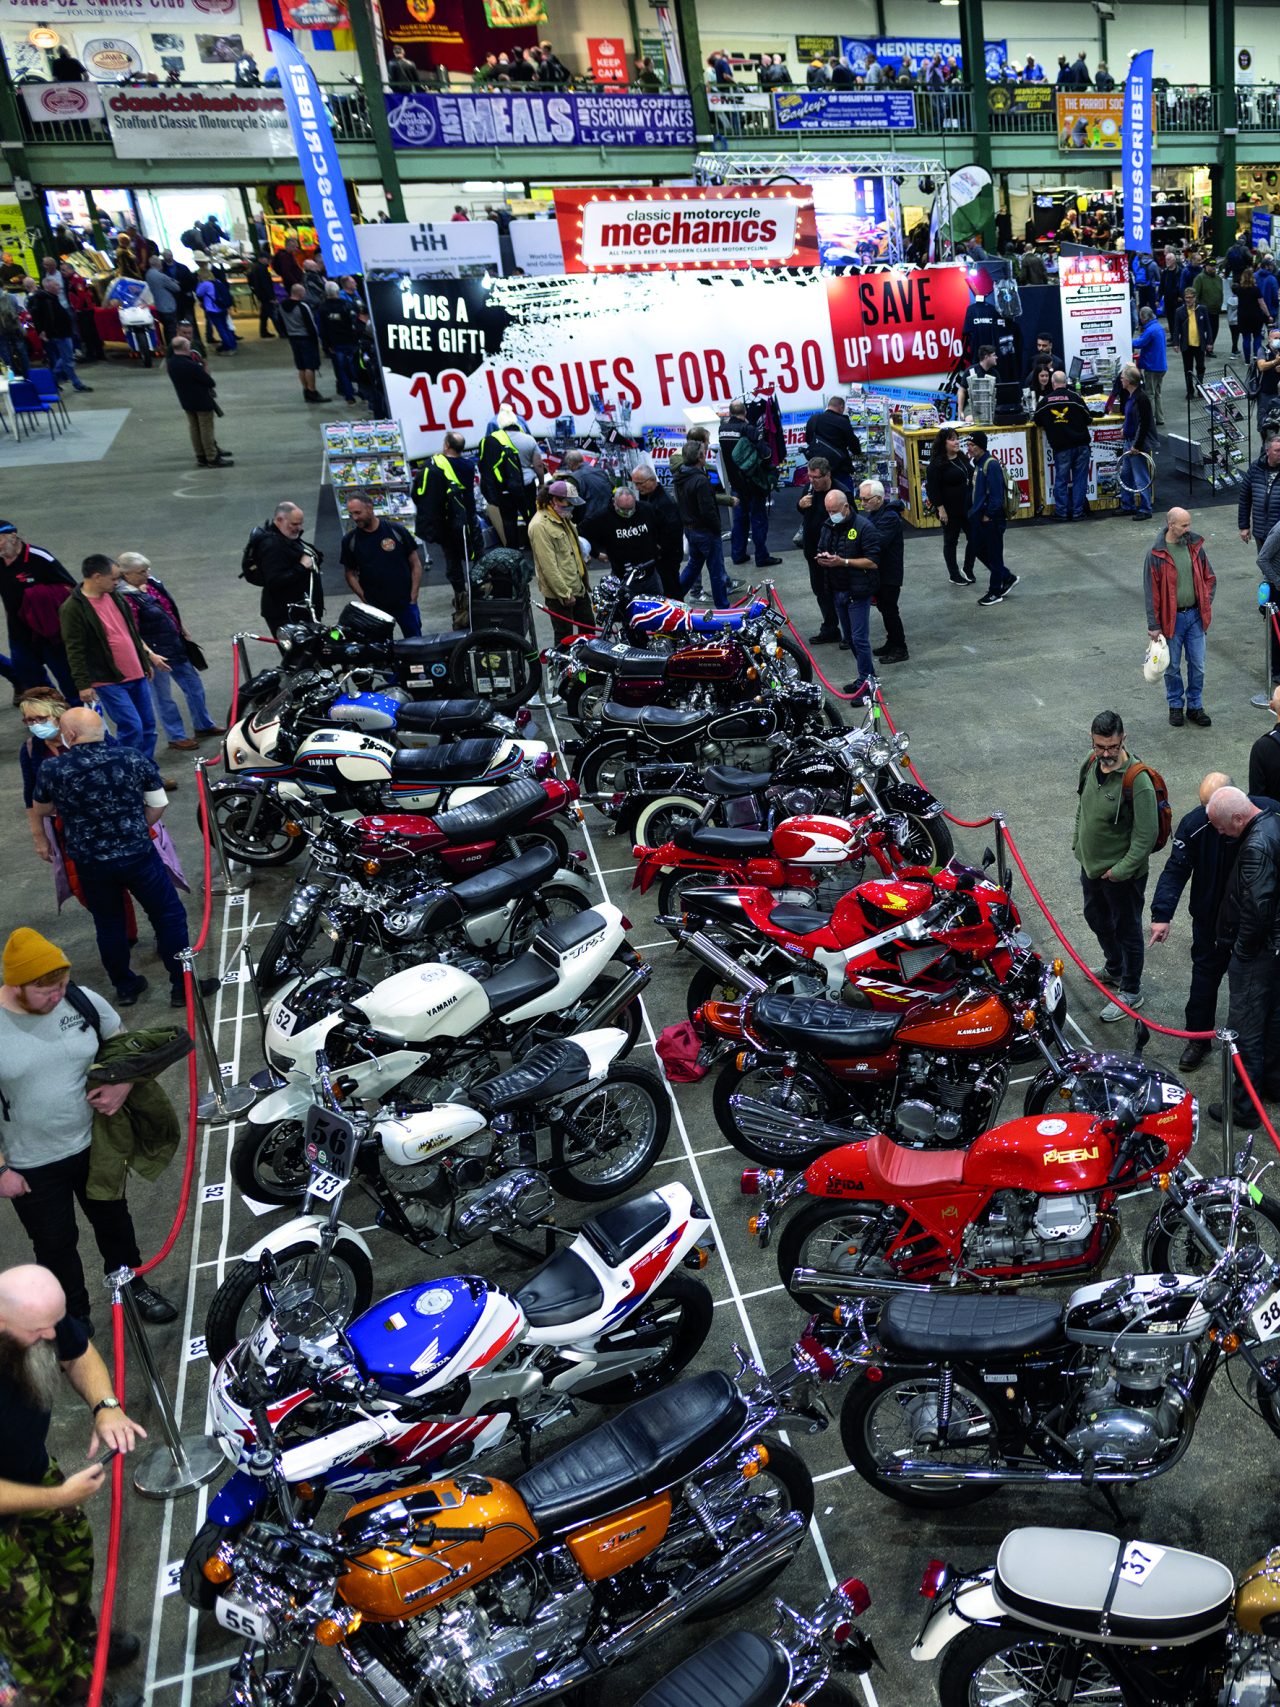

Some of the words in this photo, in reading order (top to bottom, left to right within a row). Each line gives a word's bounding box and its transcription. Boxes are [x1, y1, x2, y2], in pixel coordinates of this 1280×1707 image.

[66, 9, 113, 17] FOUNDED
[876, 42, 963, 57] HEDNESFOR
[597, 58, 621, 67] KEEP
[109, 91, 286, 113] classicbikeshows
[577, 98, 639, 109] DELICIOUS
[641, 99, 692, 110] COFFEES
[1064, 98, 1079, 110] THE
[1079, 98, 1108, 110] PARROT
[115, 112, 158, 130] Stafford
[158, 113, 197, 130] Classic
[199, 114, 257, 133] Motorcycle
[259, 116, 289, 131] Show
[436, 96, 463, 144] TASTY
[457, 97, 575, 144] MEALS
[591, 108, 652, 128] SCRUMMY
[654, 109, 694, 128] CAKES
[581, 130, 637, 143] LIGHT
[645, 131, 696, 143] BITES
[1131, 76, 1144, 241] SUBSCRIBE!
[626, 209, 671, 221] classic
[683, 208, 761, 220] motorcycle
[601, 211, 777, 247] mechanics
[402, 293, 451, 321] PLUS
[456, 297, 469, 323] A
[859, 277, 935, 327] SAVE
[387, 324, 433, 352] FREE
[438, 327, 486, 355] GIFT!
[843, 337, 872, 369] UP
[877, 334, 905, 364] TO
[911, 328, 964, 361] 46%
[410, 373, 474, 433] 12
[485, 356, 643, 422] ISSUES
[655, 348, 732, 406] FOR
[748, 338, 825, 397] £30
[665, 440, 687, 448] classi
[991, 446, 1024, 468] SUES
[1009, 467, 1024, 479] £30
[307, 759, 335, 767] YAMAHA
[882, 903, 908, 911] HONDA
[854, 975, 941, 999] VTR
[426, 995, 458, 1018] YAMAHA
[275, 1009, 292, 1031] 52
[956, 1025, 992, 1036] KAWASAKI
[1166, 1087, 1184, 1101] 39
[311, 1119, 347, 1157] 56
[205, 1186, 225, 1199] 52
[316, 1176, 341, 1195] 53
[827, 1175, 865, 1191] SPIDA
[414, 1356, 451, 1380] HONDA
[1121, 1548, 1152, 1576] 37
[402, 1563, 472, 1604] SUZUKI
[225, 1608, 256, 1637] 55
